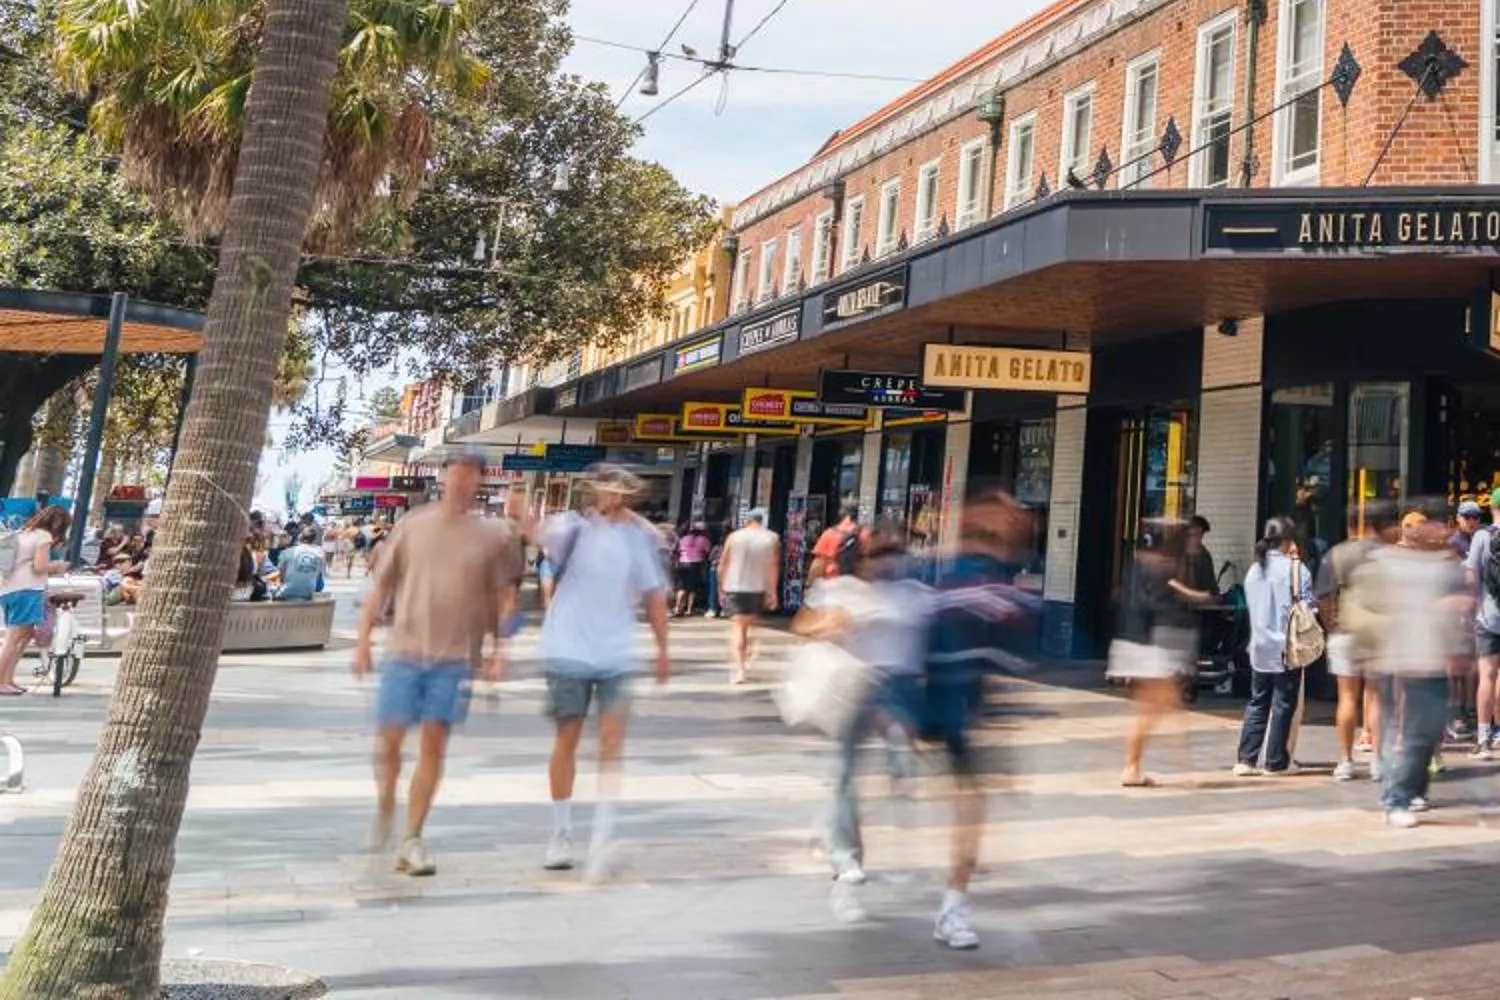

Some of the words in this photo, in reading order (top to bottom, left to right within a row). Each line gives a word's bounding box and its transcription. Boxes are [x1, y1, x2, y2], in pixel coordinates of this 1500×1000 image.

[1298, 211, 1383, 243] ANITA
[1398, 210, 1500, 242] GELATO
[933, 352, 1000, 378] ANITA
[1008, 356, 1085, 382] GELATO
